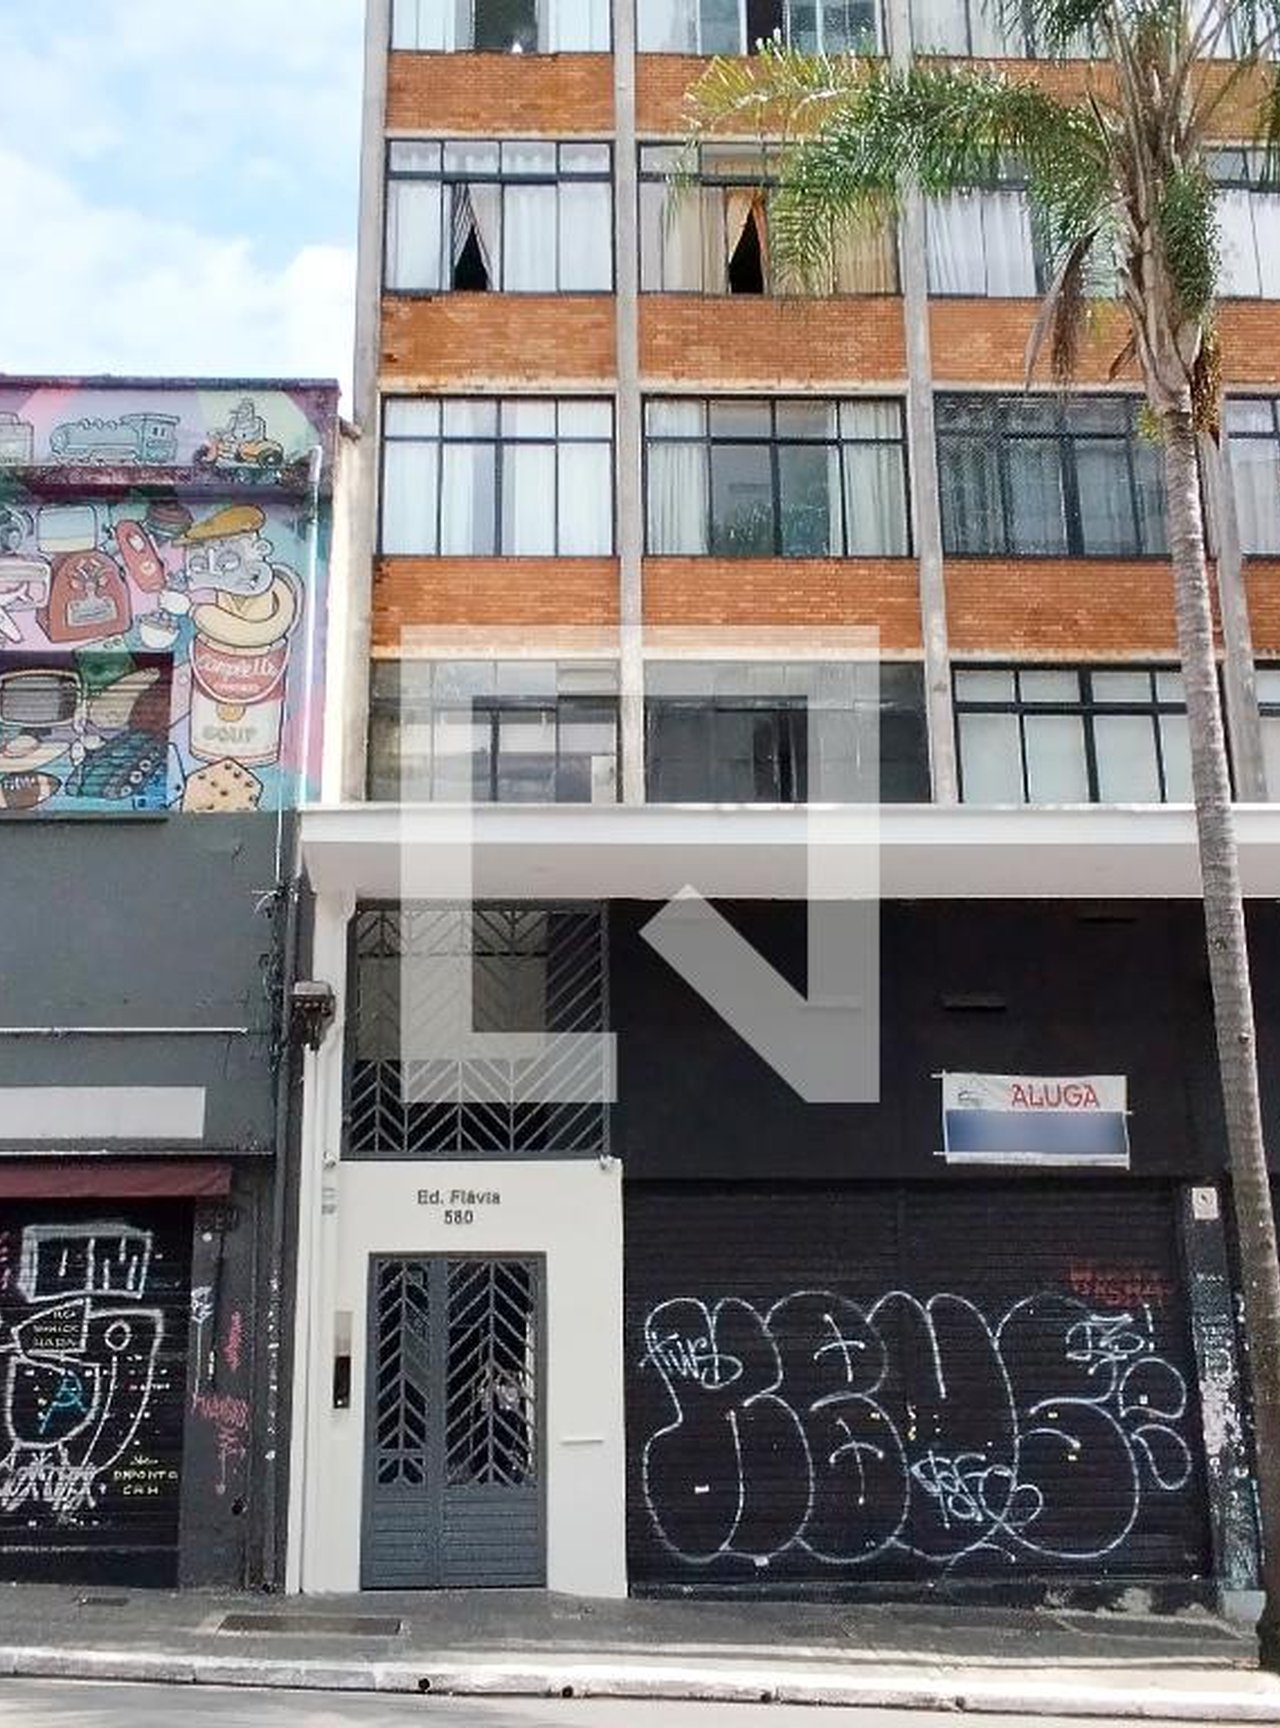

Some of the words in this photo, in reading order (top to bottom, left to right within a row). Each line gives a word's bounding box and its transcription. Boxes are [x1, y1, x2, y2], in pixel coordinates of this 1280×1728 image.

[1011, 1083, 1100, 1109] ALUGA
[417, 1189, 445, 1205] Ed.
[449, 1189, 501, 1205] Flávia
[443, 1209, 474, 1225] 580
